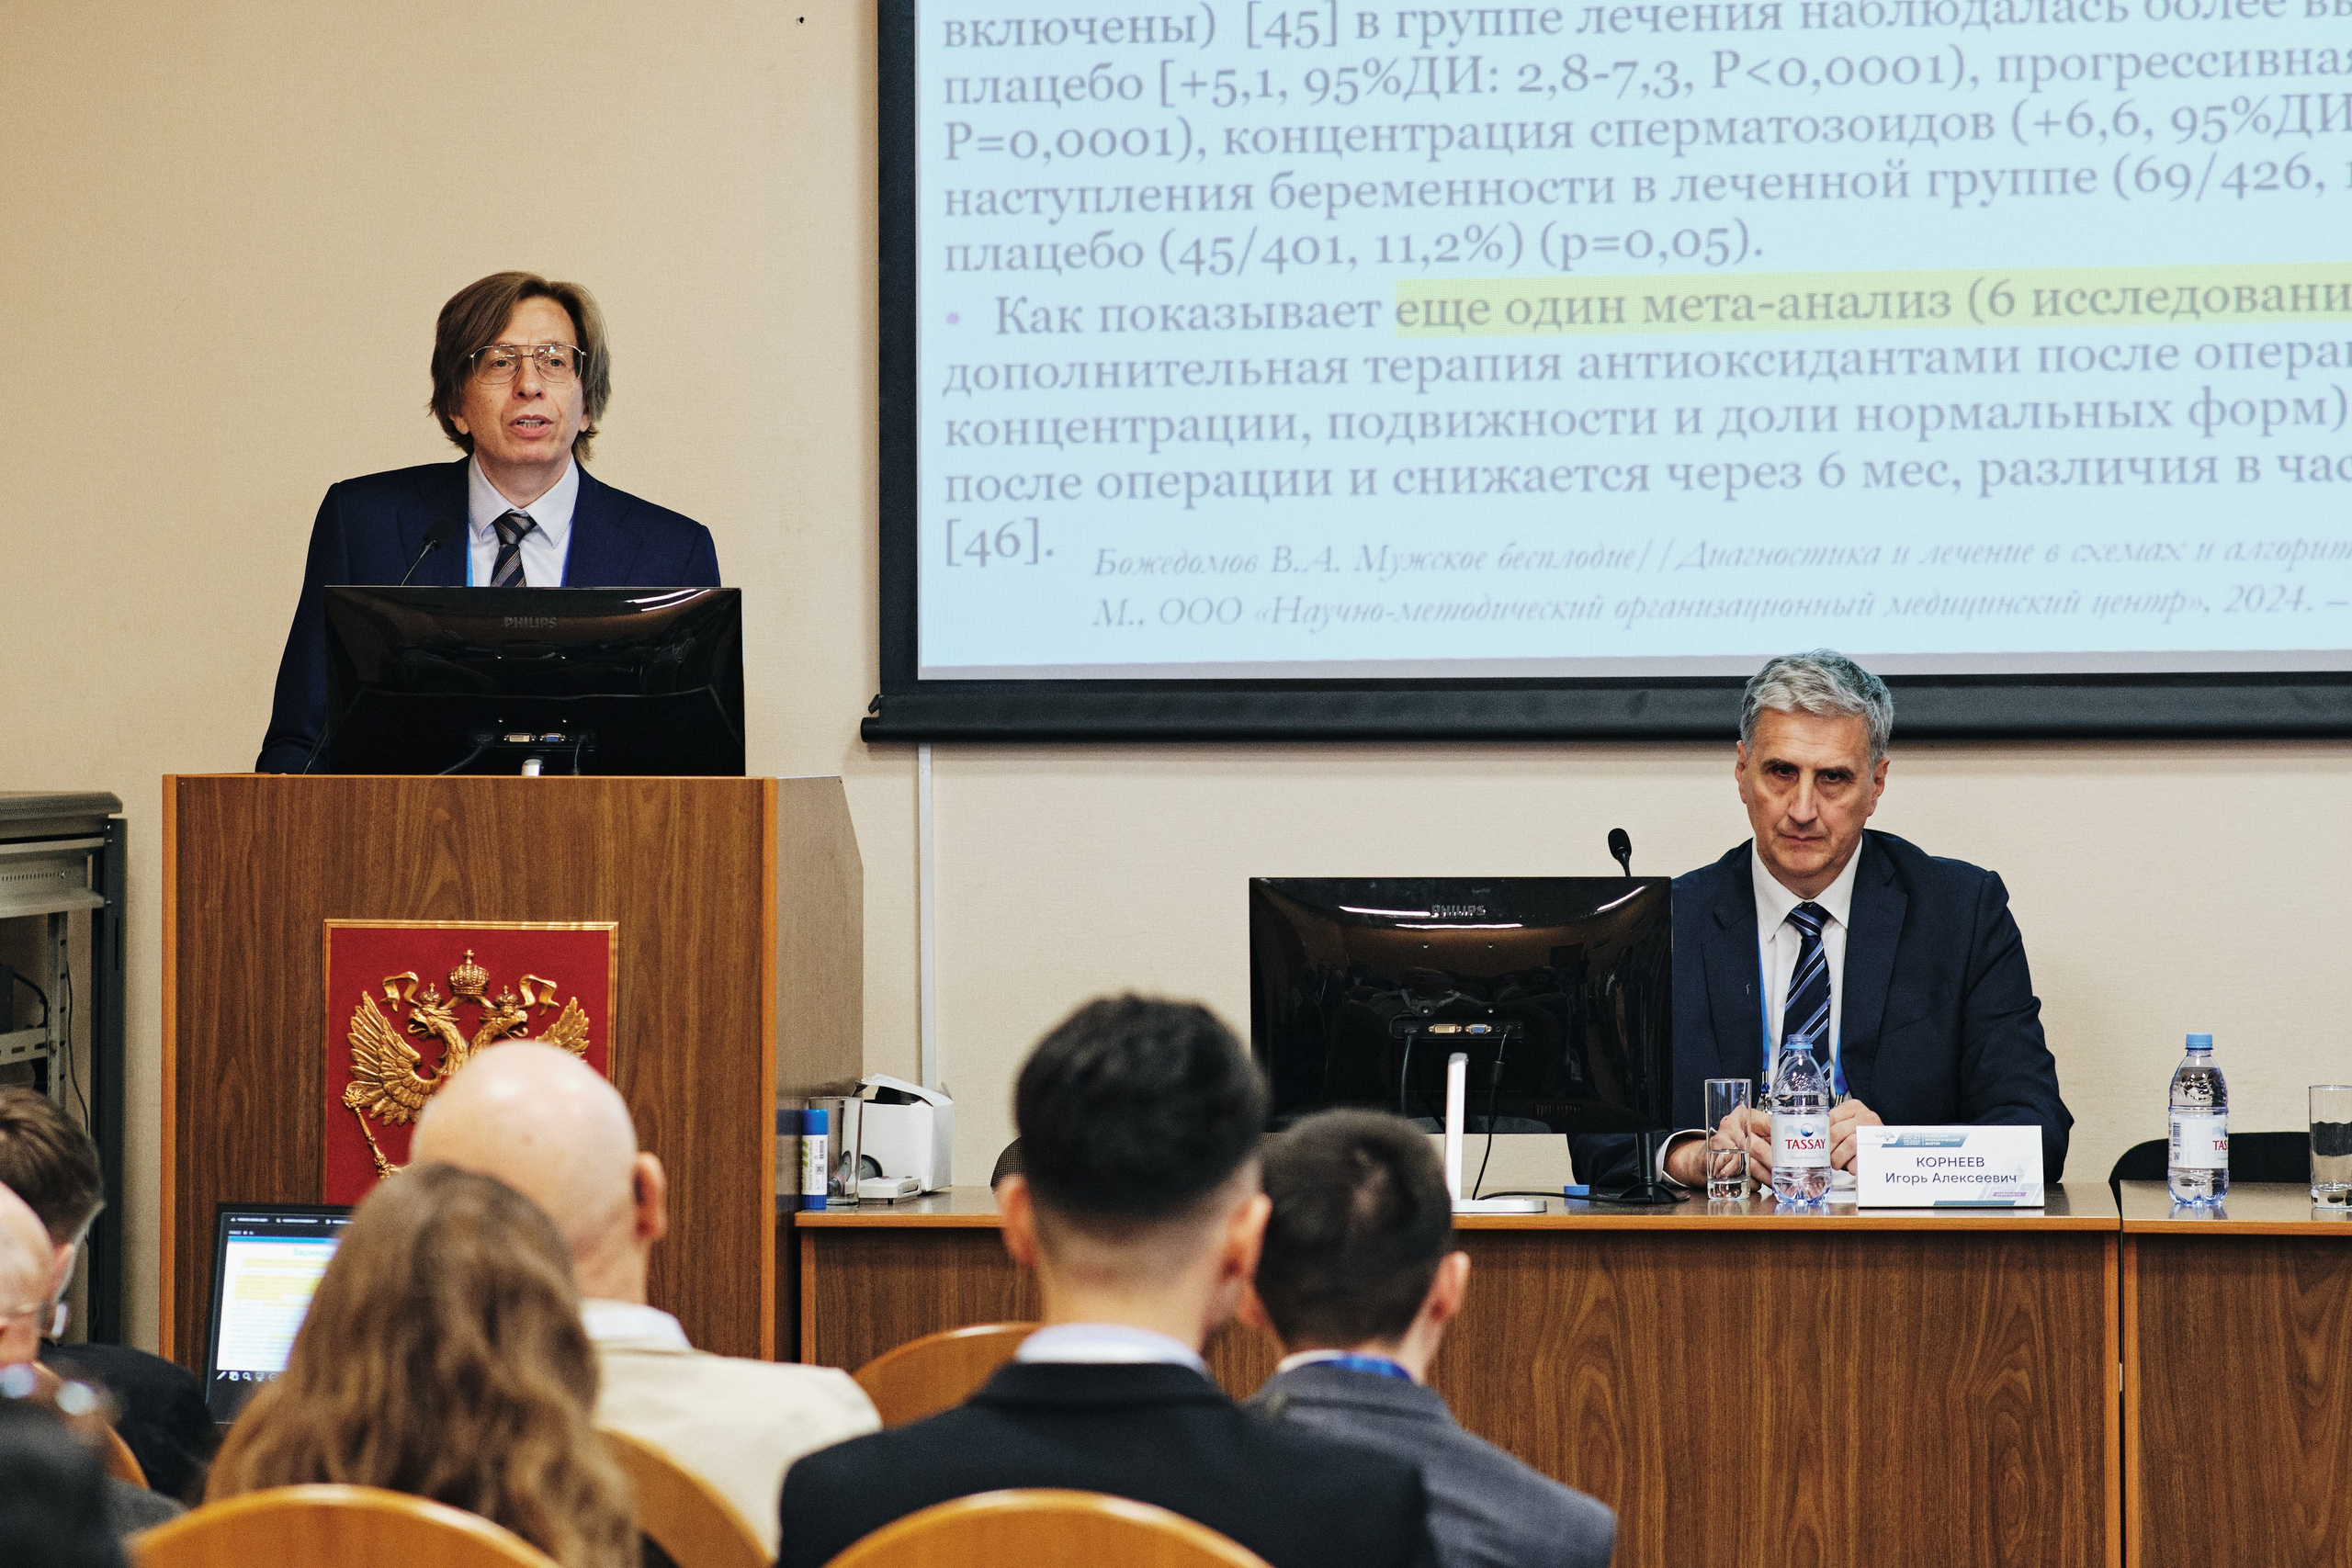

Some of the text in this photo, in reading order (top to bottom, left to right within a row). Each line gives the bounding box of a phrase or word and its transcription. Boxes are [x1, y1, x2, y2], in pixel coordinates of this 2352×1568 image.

[944, 2, 1216, 50] включены)
[1246, 0, 1339, 50] [45]
[1355, 11, 1381, 40] в
[1396, 7, 1564, 49] группе
[1575, 2, 1782, 35] лечения
[1800, 0, 2130, 31] наблюдалась
[944, 43, 2352, 109] плацебо [+5,1, 95%ДИ: 2,8-7,3, P<0,0001), прогрессивна
[944, 116, 1206, 164] P=0,0001),
[1224, 120, 1574, 162] концентрация
[1589, 112, 1996, 159] сперматозоидов
[2010, 98, 2154, 146] (+6,6,
[944, 183, 1254, 225] наступления
[1268, 169, 1615, 221] беременности
[1633, 175, 1657, 204] в
[1668, 158, 1909, 203] леченной
[1927, 167, 2098, 209] группе
[2112, 151, 2325, 203] (69/426,
[944, 217, 1763, 277] плацебо (45/401, 11,2%) (p=0,05).
[995, 295, 1084, 336] Как
[1099, 299, 1383, 334] показывает
[1394, 299, 1491, 333] еще
[1504, 296, 1625, 331] один
[1643, 290, 1952, 324] мета-анализ
[1967, 277, 2016, 324] (6
[941, 340, 2352, 399] дополнительная терапия антиоксидантами после опера
[945, 383, 2348, 455] концентрации, подвижности и доли нормальных форм)
[944, 473, 1083, 504] после
[1095, 468, 1332, 511] операции
[1349, 468, 1377, 497] и
[1392, 464, 1650, 496] снижается
[1666, 462, 1803, 502] через
[1817, 451, 1846, 489] 6
[1861, 459, 1962, 492] мес,
[1978, 456, 2218, 500] различия
[2235, 455, 2261, 484] в
[945, 516, 1055, 569] [46].
[1092, 547, 1259, 578] Божедомов
[1352, 543, 1487, 583] Мужское
[1891, 545, 1911, 566] и
[1917, 543, 2036, 566] лечение
[2043, 543, 2060, 564] в
[2070, 541, 2187, 564] схемах
[2194, 541, 2215, 562] и
[503, 616, 557, 628] PHILIPS
[1158, 596, 1244, 625] ООО
[1612, 591, 1876, 631] организационный
[1883, 588, 2082, 621] медицинский
[2222, 583, 2313, 614] 2024.
[1431, 905, 1486, 917] PHILIPS
[1785, 1138, 1826, 1150] TASSAY
[1917, 1156, 1985, 1168] КОРНЕЕВ
[1885, 1172, 2017, 1185] Игорь Алексеевич
